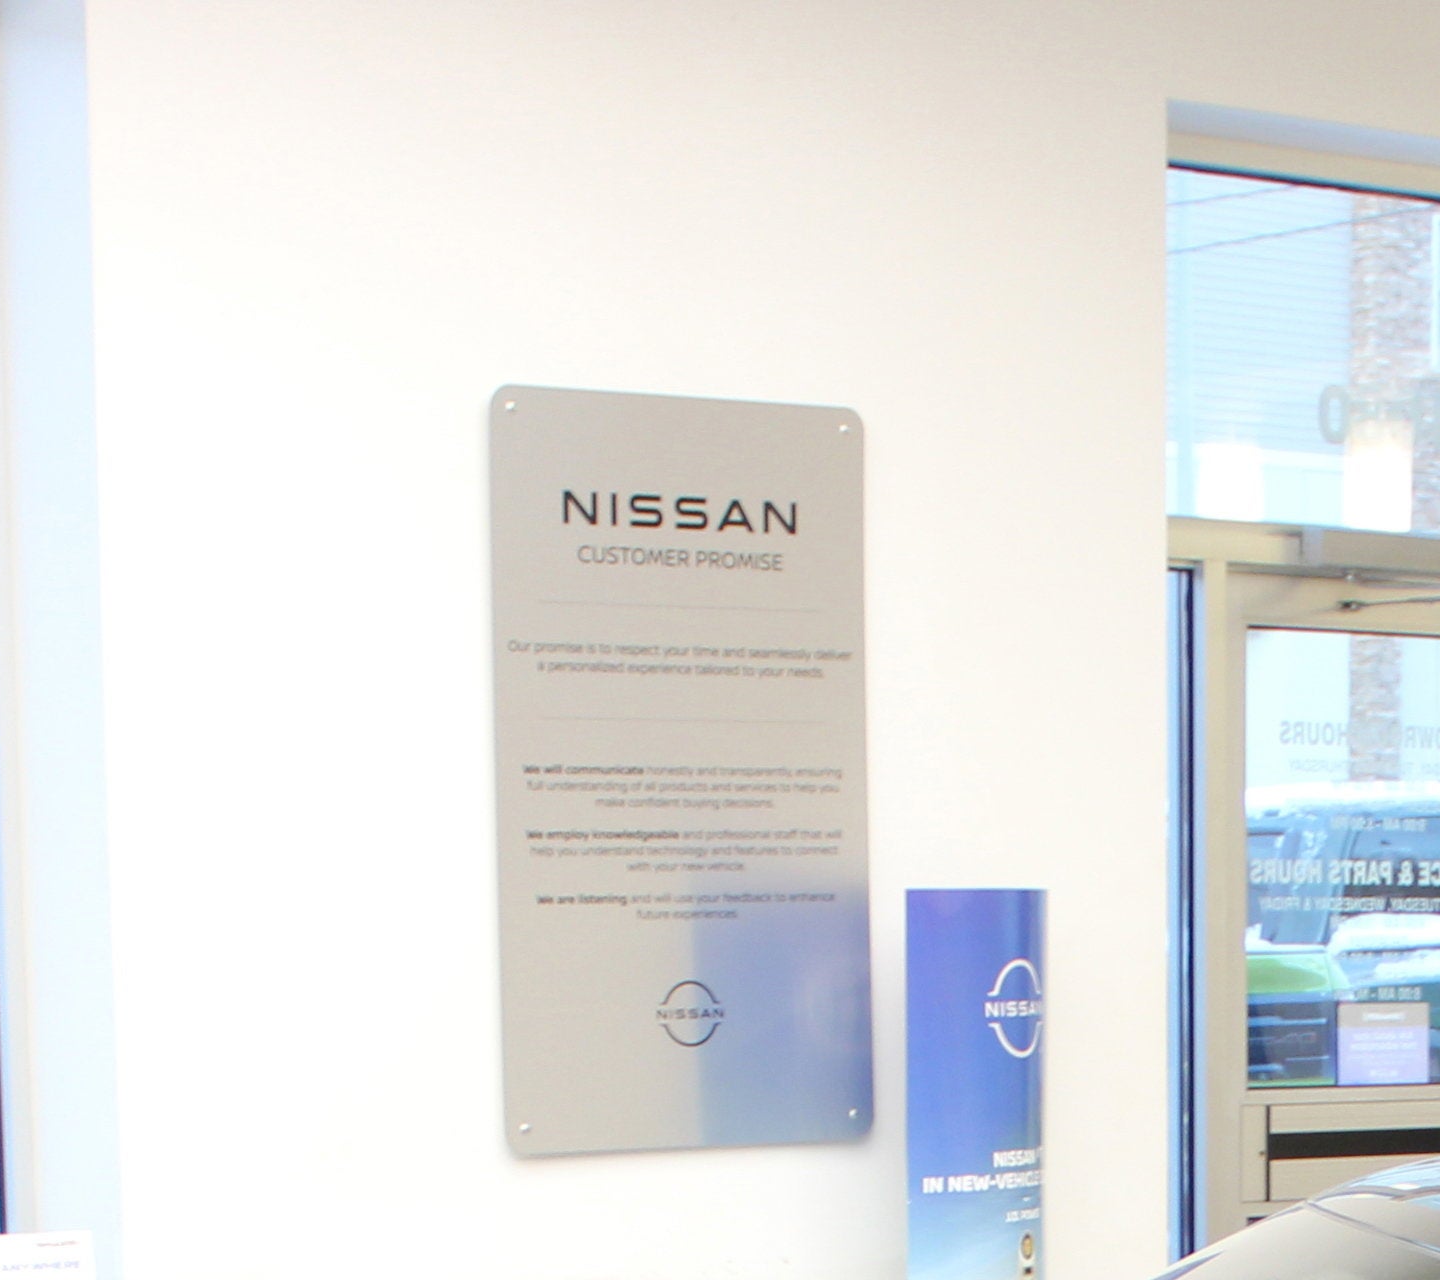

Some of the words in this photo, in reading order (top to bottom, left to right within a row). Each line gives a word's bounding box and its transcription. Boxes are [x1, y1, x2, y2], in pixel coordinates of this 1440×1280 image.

[562, 490, 799, 535] NISSAN
[577, 544, 690, 568] CUSTOMER
[694, 549, 785, 571] PROMISE
[656, 1008, 724, 1020] NISSAN
[922, 1176, 944, 1194] IN
